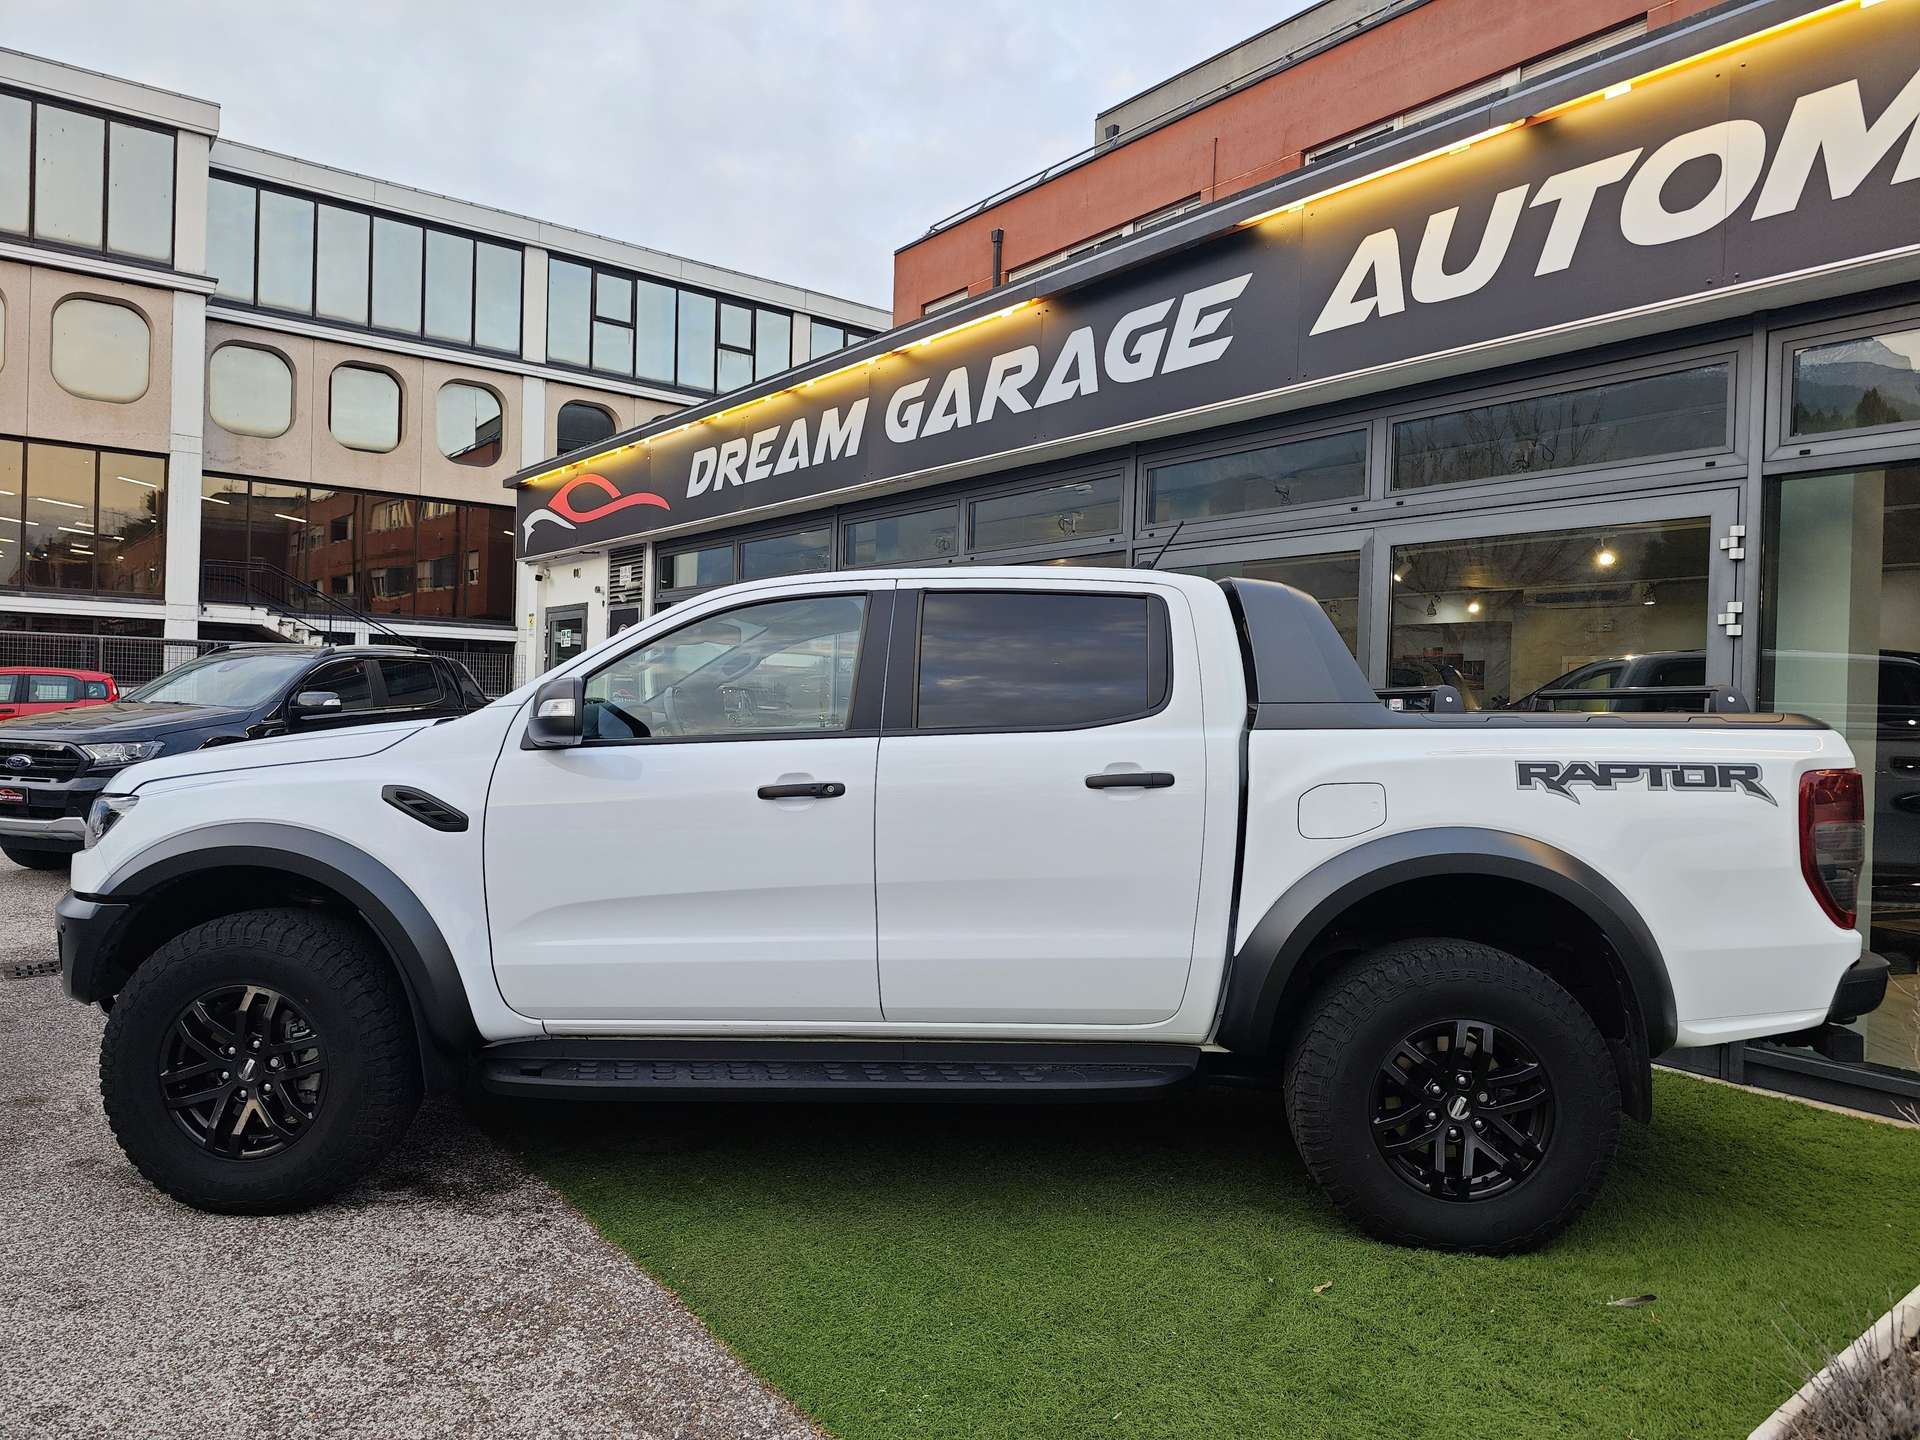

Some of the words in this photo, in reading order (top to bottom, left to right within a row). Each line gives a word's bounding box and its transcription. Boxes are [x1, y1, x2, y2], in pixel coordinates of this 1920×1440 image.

[686, 397, 869, 498] DREAM
[885, 272, 1254, 443] GARAGE
[1309, 68, 1920, 336] AUTOM
[1515, 760, 1778, 807] RAPTOR
